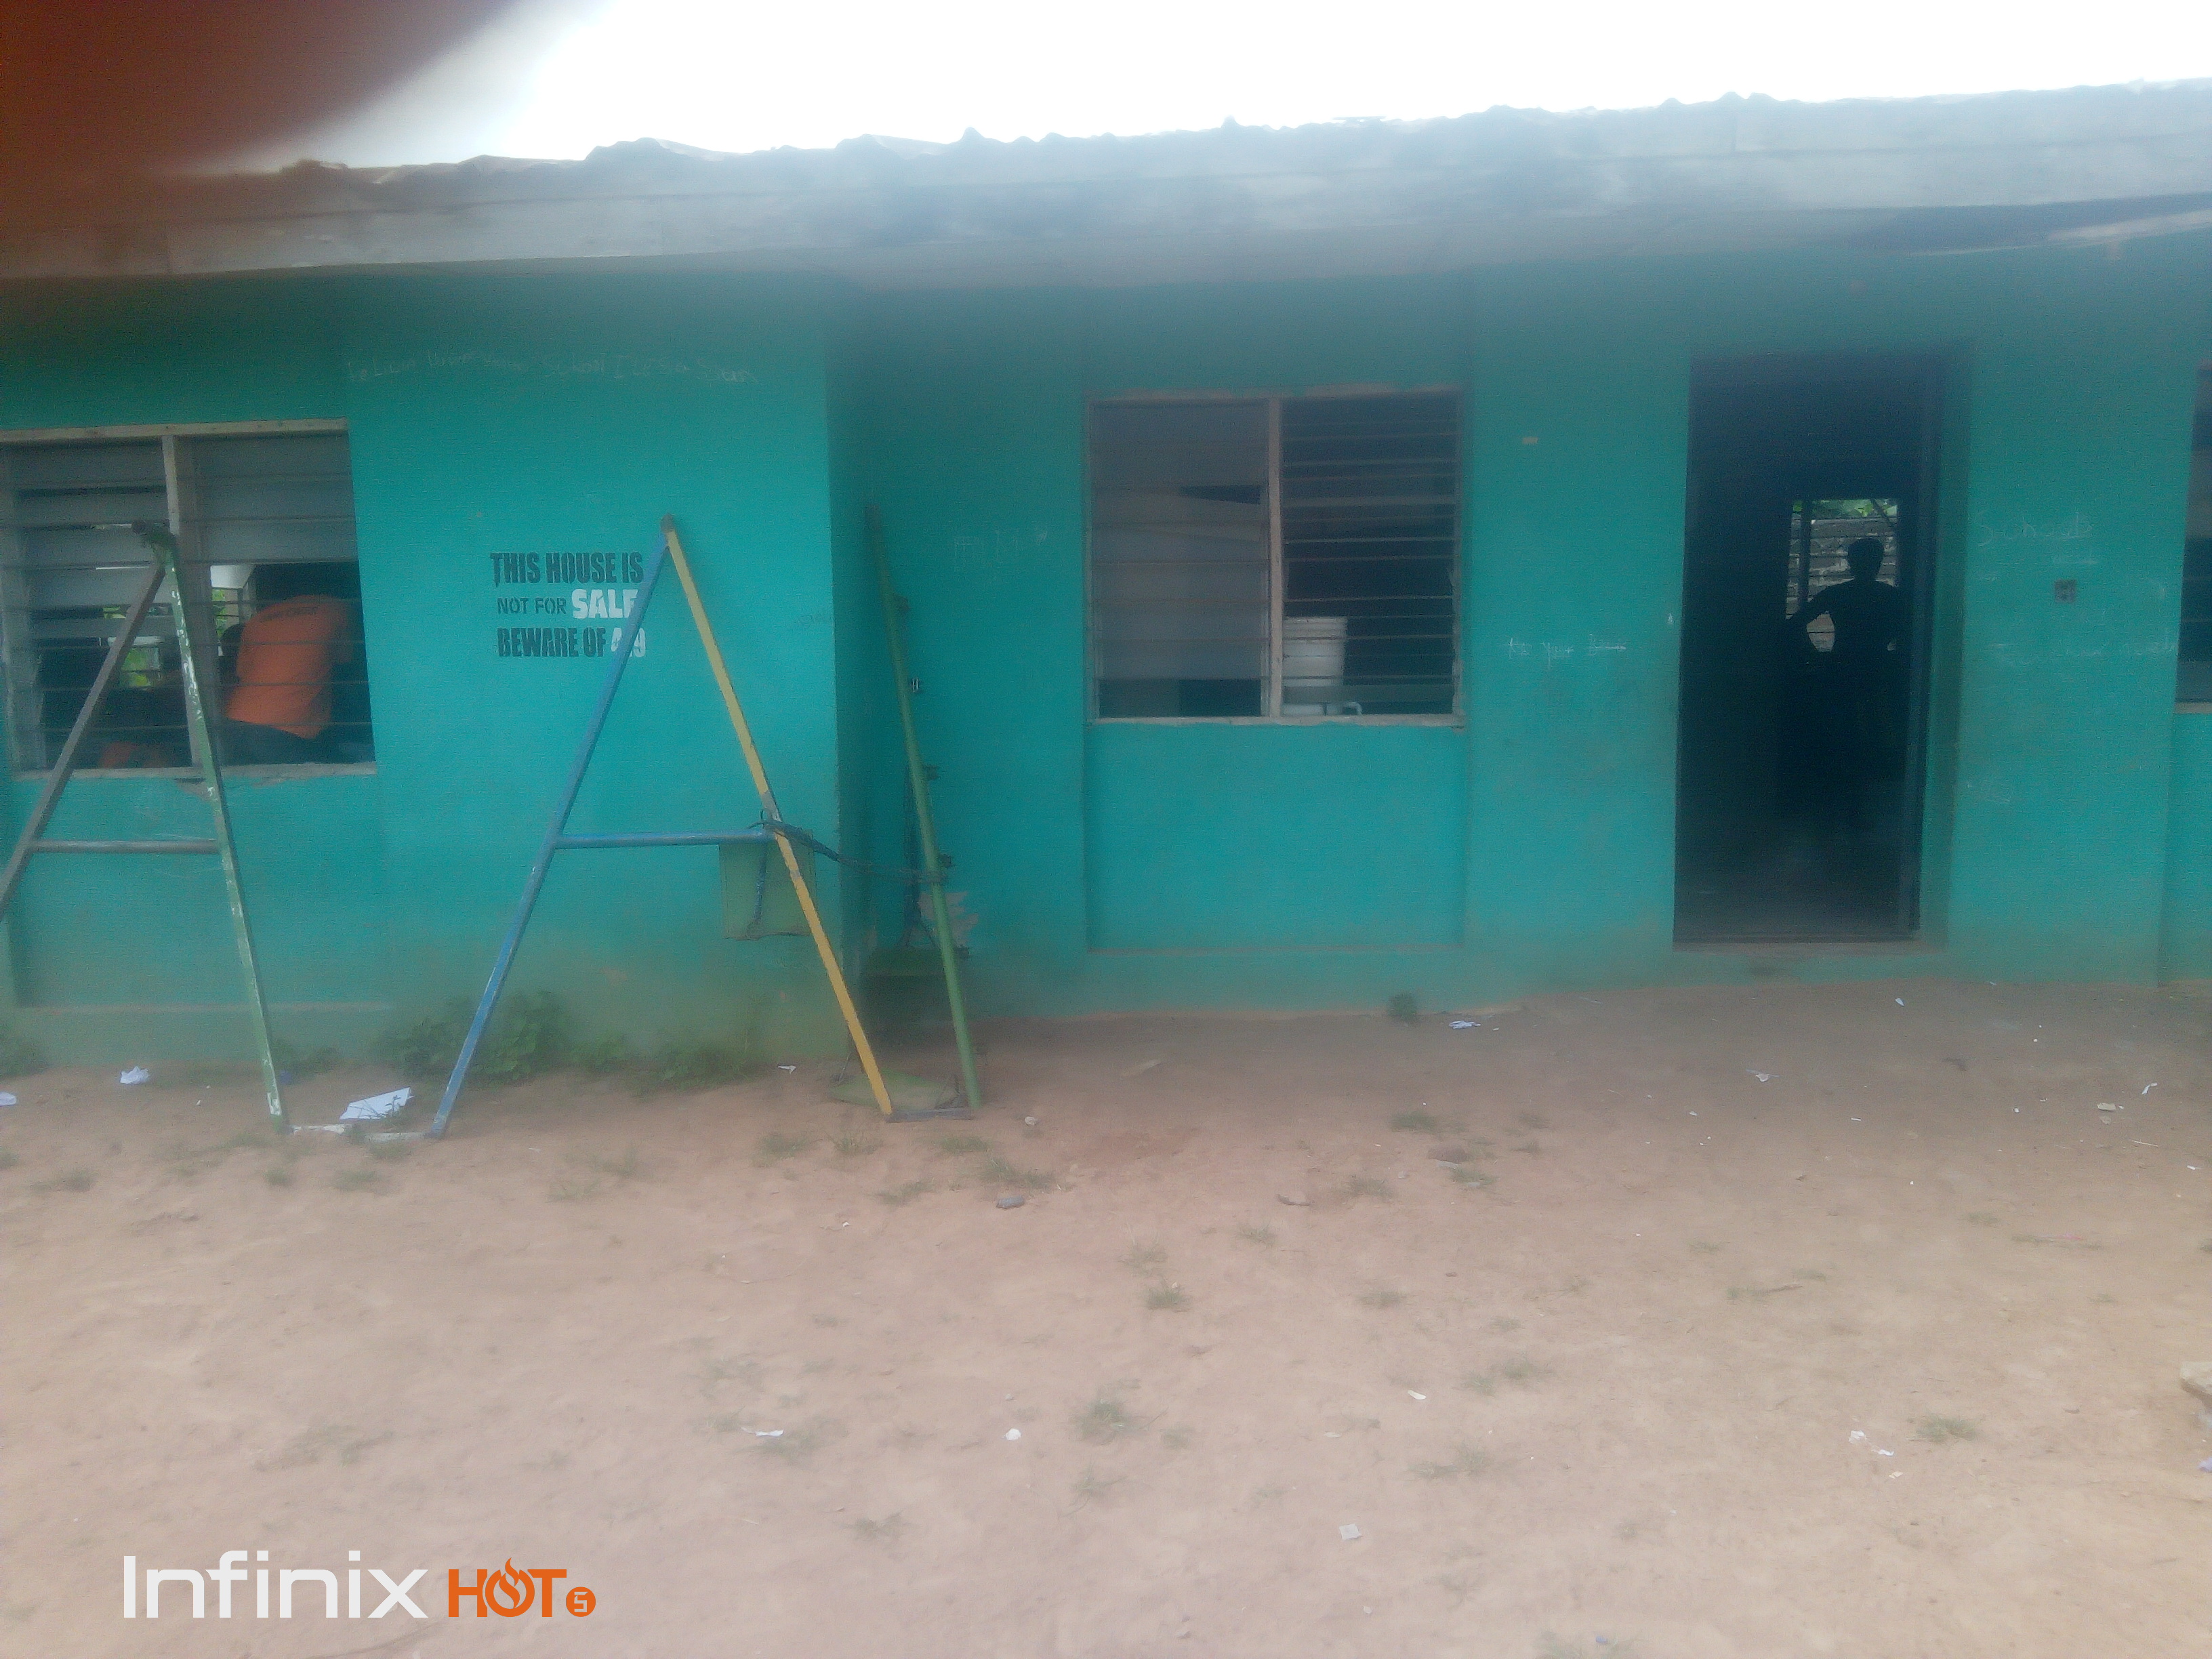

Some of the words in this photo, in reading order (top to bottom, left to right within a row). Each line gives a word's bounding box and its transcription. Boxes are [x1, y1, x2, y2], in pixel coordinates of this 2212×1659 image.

[489, 552, 541, 587] THIS
[545, 552, 617, 583] HOUSE
[621, 552, 643, 583] IS
[496, 596, 529, 615] NOT
[534, 596, 567, 615] FOR
[496, 627, 579, 657] BEWARE
[582, 627, 606, 657] OF
